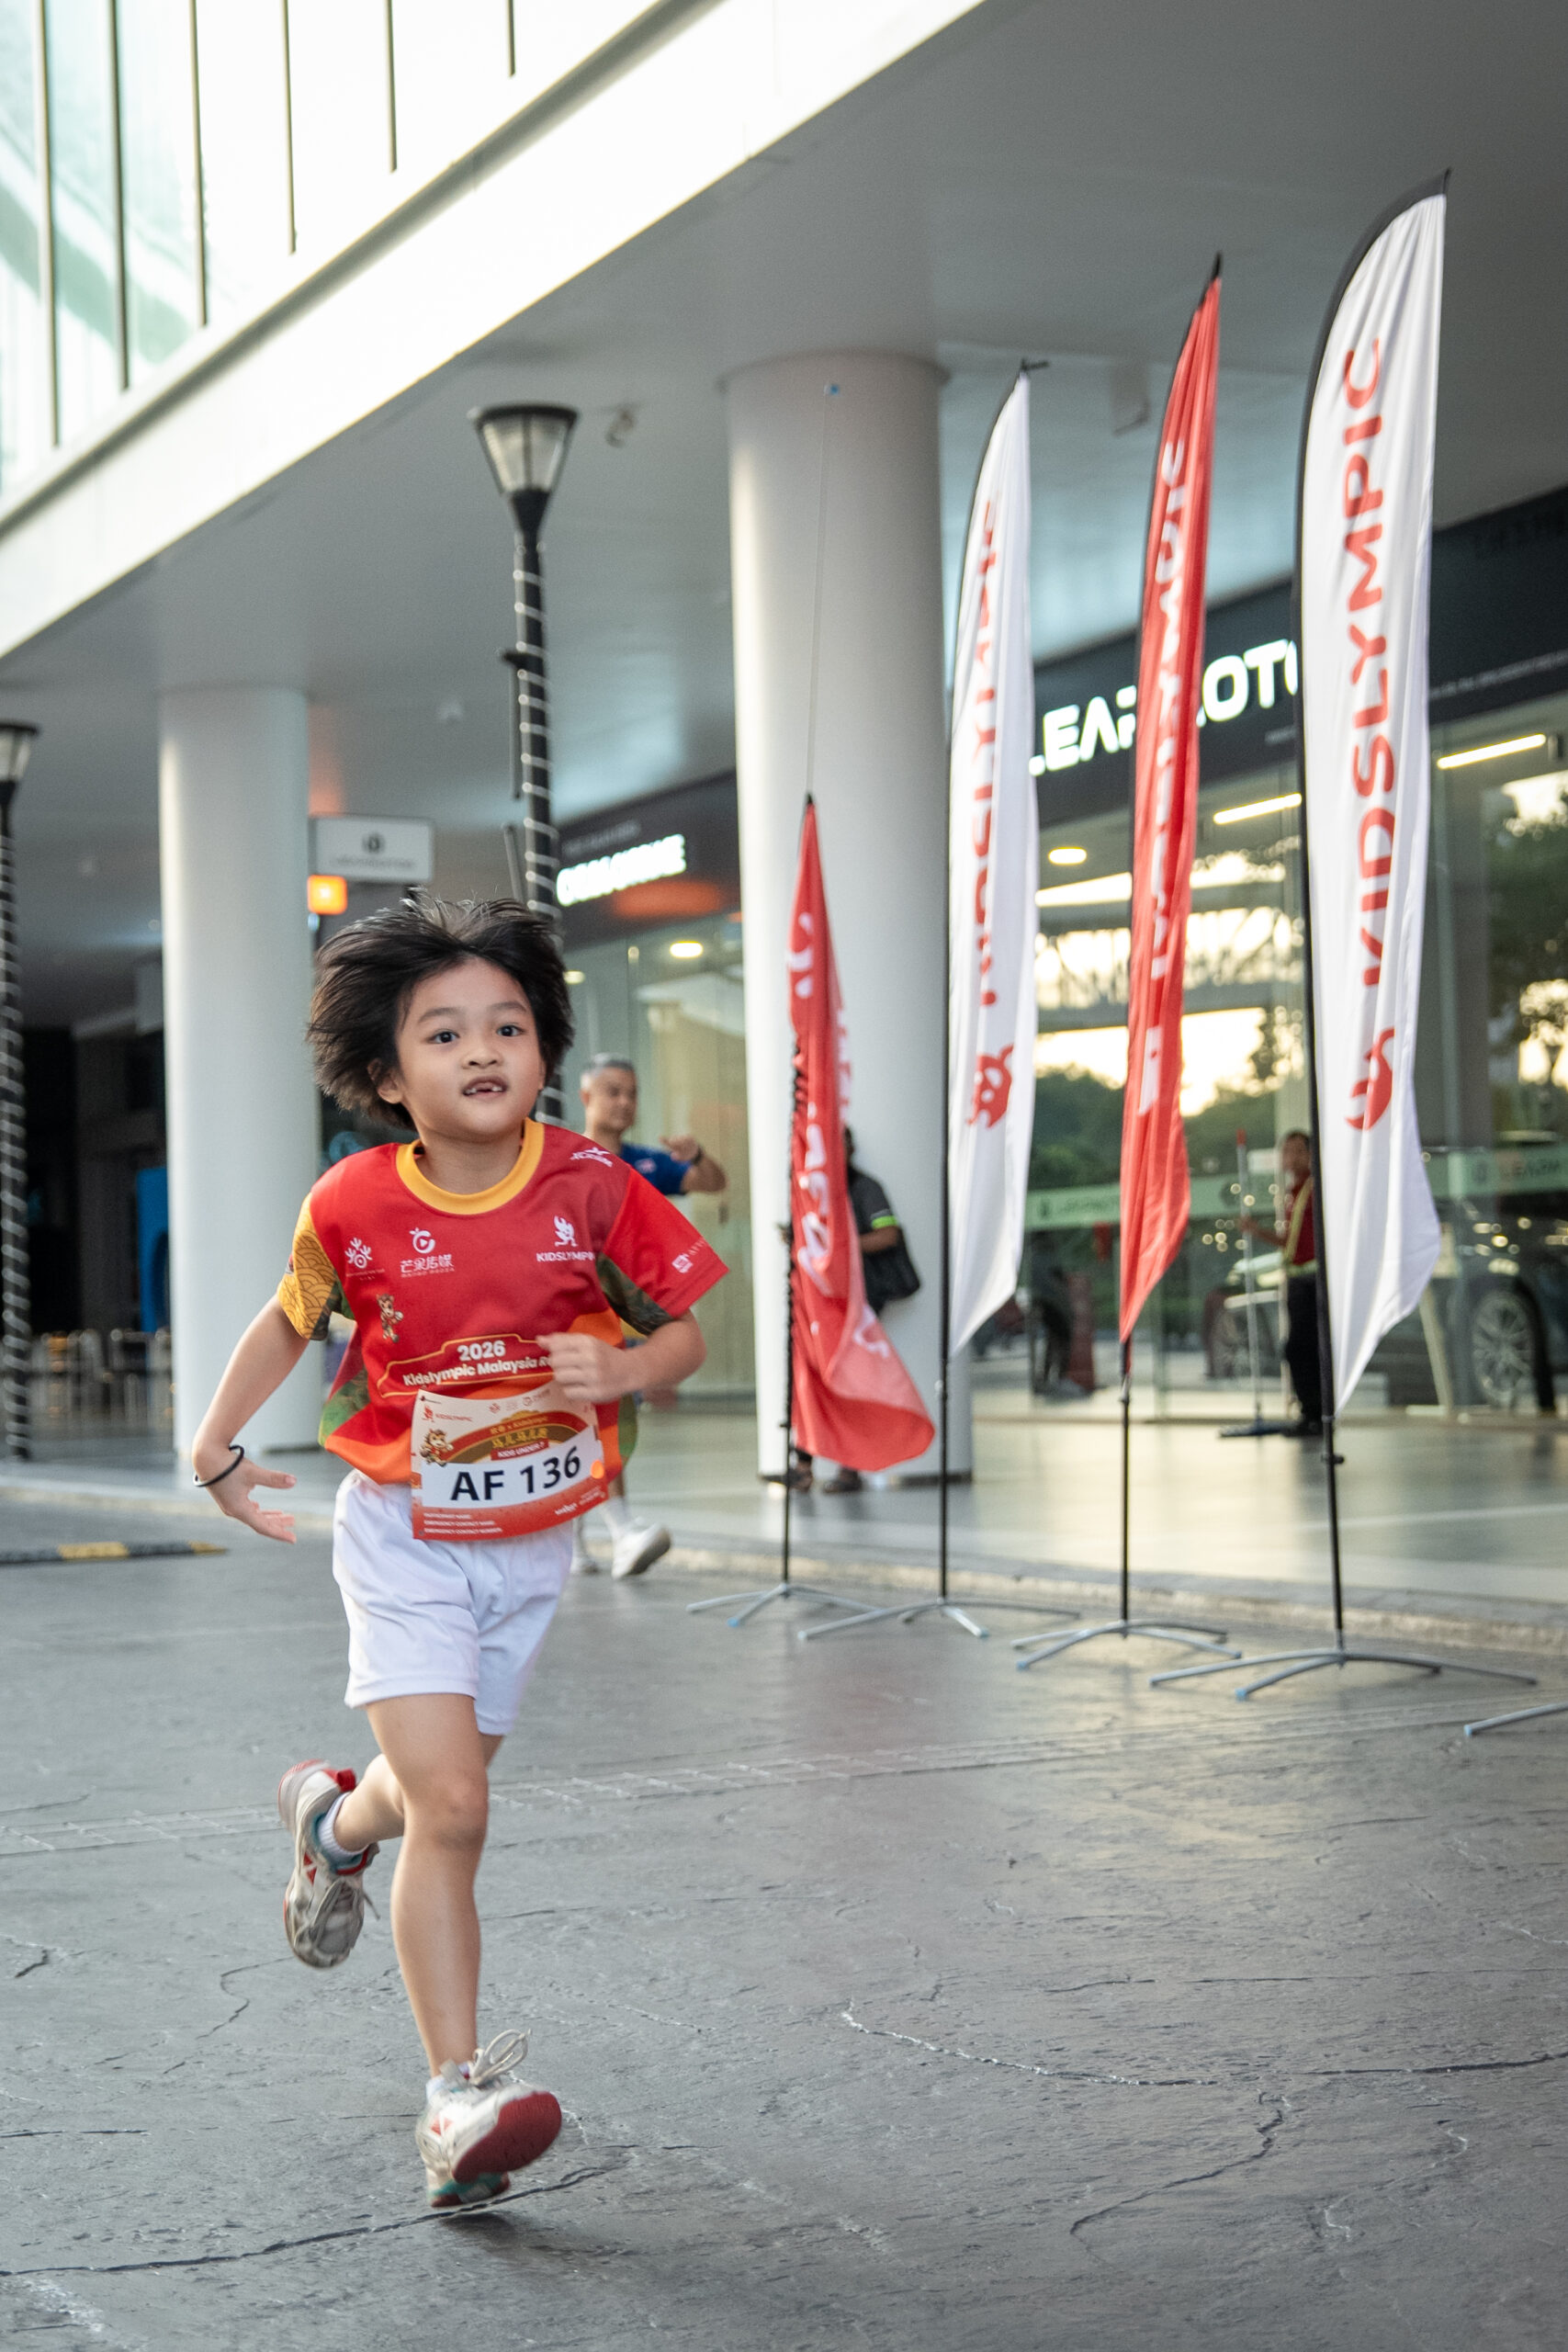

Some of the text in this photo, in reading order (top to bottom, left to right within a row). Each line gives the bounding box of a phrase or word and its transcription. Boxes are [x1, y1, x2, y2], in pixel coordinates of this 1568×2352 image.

[457, 1340, 506, 1362] 2026
[402, 1364, 476, 1387] Kidslympic
[477, 1357, 537, 1375] Malaysia
[450, 1446, 581, 1501] AF 136
